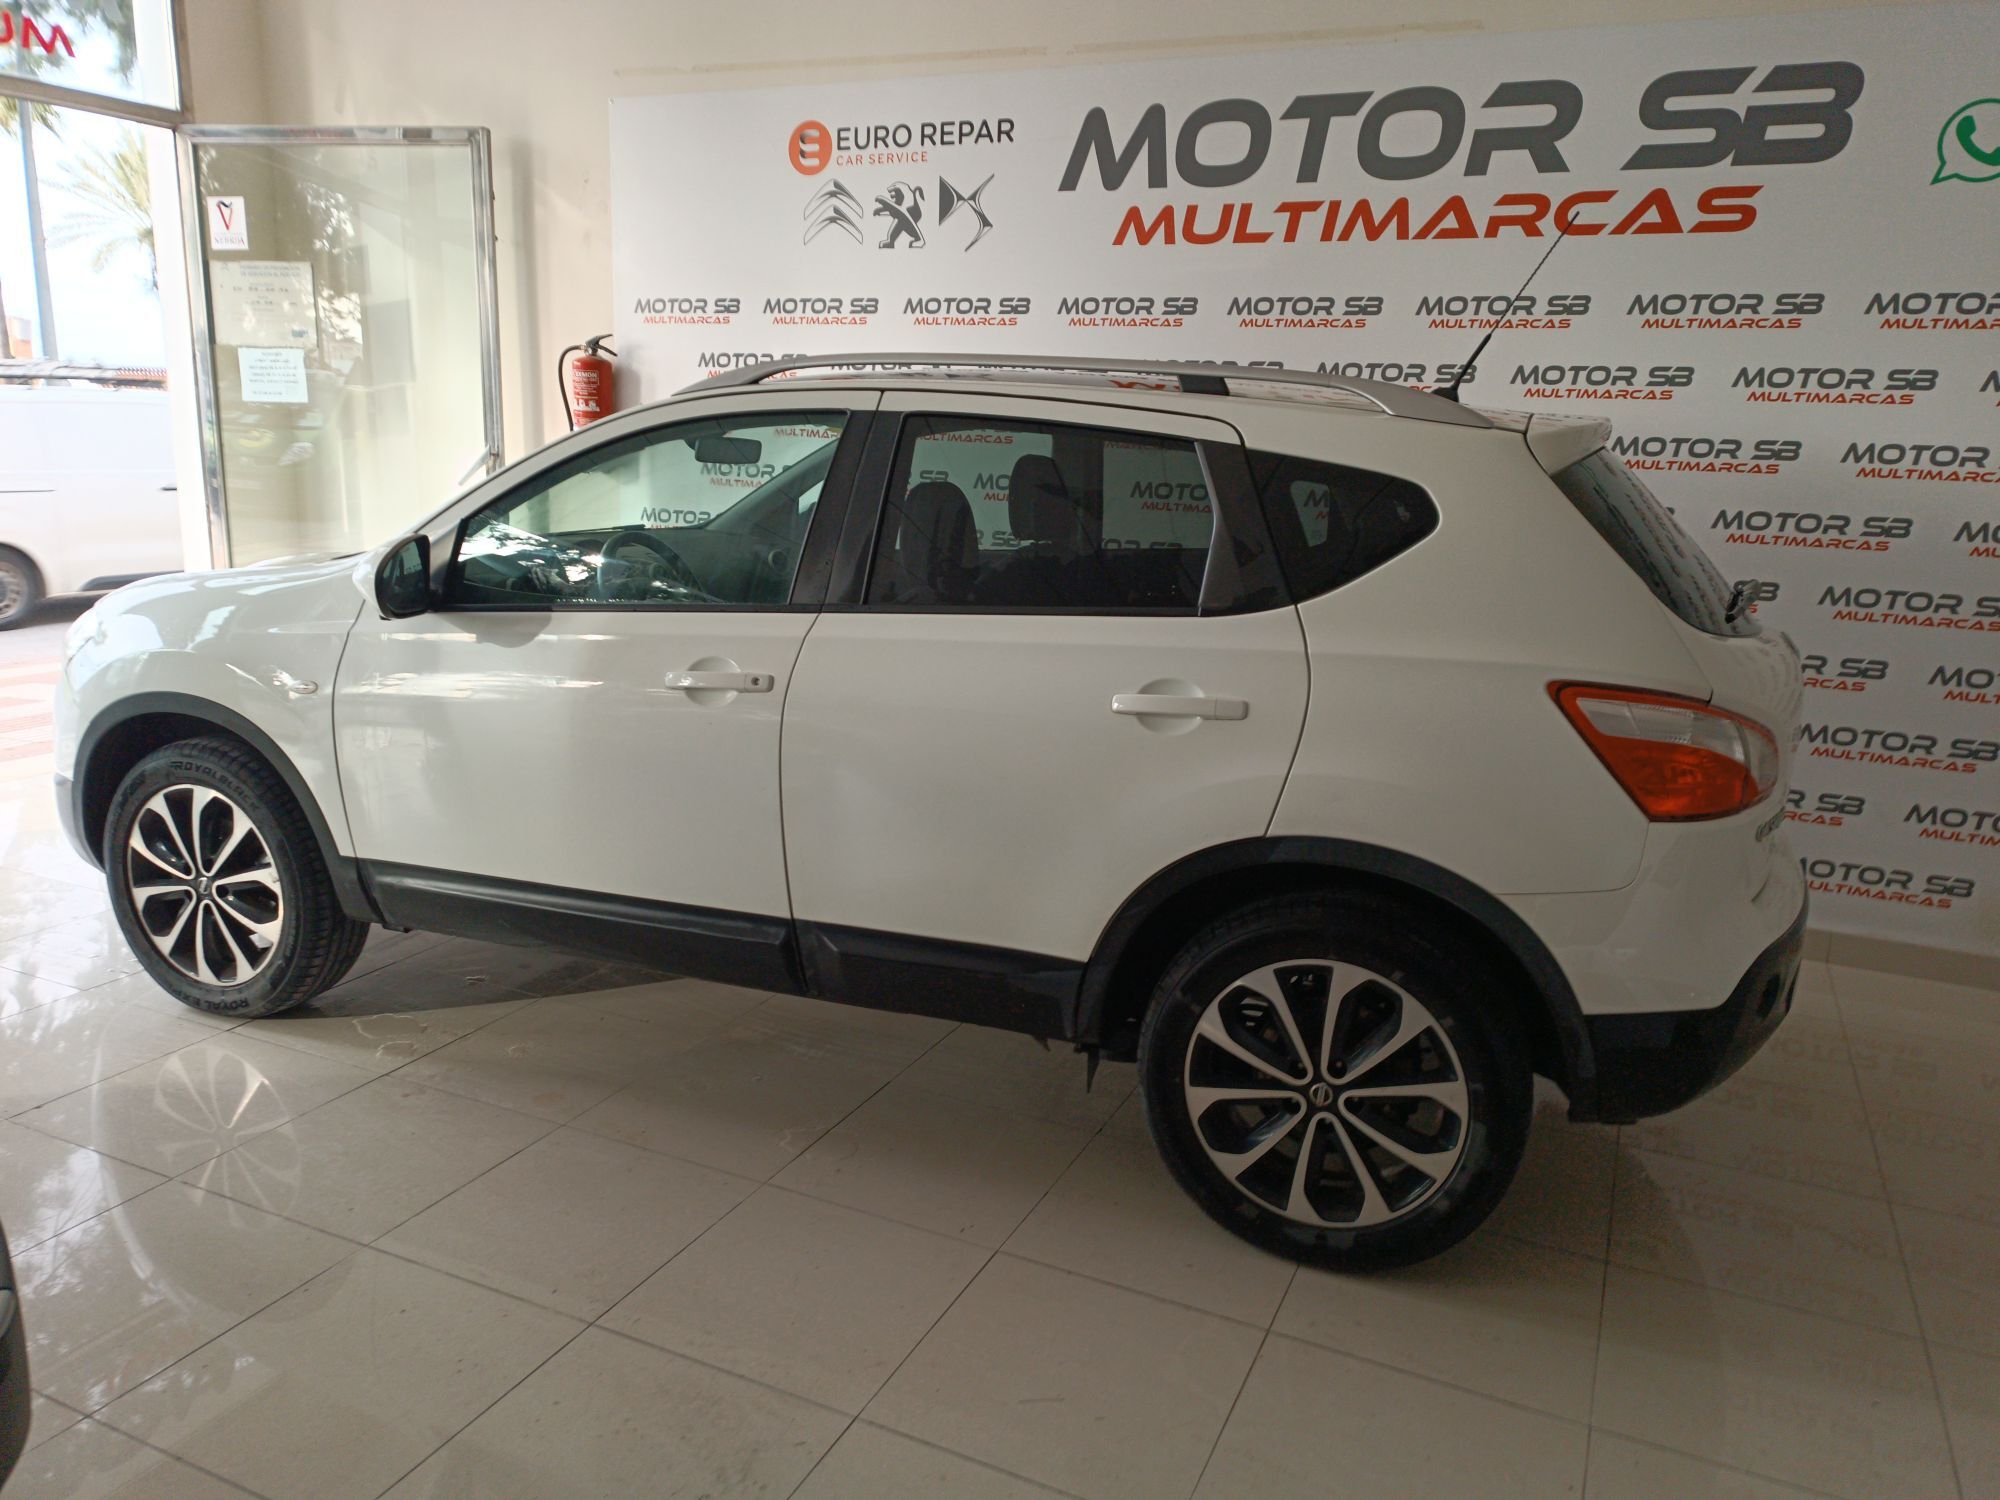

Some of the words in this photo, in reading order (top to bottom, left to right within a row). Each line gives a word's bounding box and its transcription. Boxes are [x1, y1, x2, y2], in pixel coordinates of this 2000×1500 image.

[837, 124, 912, 150] EURO
[921, 119, 1014, 146] REPAR
[1057, 80, 1584, 192] MOTOR
[1620, 61, 1864, 170] SB
[836, 154, 863, 166] CAR
[870, 152, 928, 163] SERVICE
[1112, 186, 1762, 245] MULTIMARCAS
[635, 298, 707, 313] MOTOR
[714, 298, 740, 313] SB
[763, 298, 842, 314] MOTOR
[850, 298, 878, 314] SB
[904, 298, 991, 314] MOTOR
[998, 298, 1030, 314] SB
[1058, 297, 1154, 315] MOTOR
[1162, 297, 1198, 315] SB
[1227, 297, 1335, 315] MOTOR
[1343, 297, 1383, 315] SB
[1416, 295, 1538, 316] MOTOR
[1545, 295, 1591, 315] SB
[1627, 294, 1763, 315] MOTOR
[1772, 293, 1825, 314] SB
[642, 315, 731, 324] MULTIMARCAS
[772, 316, 867, 326] MULTIMARCAS
[915, 317, 1017, 326] MULTIMARCAS
[1069, 317, 1182, 327] MULTIMARCAS
[1240, 318, 1365, 328] MULTIMARCAS
[1429, 319, 1569, 329] MULTIMARCAS
[1642, 318, 1800, 328] MULTIMARCAS
[1317, 361, 1425, 382] MOTOR
[1433, 364, 1477, 383] SB
[1510, 365, 1637, 386] MOTOR
[1645, 367, 1694, 386] SB
[1732, 367, 1874, 389] MOTOR
[1884, 369, 1938, 390] SB
[1524, 388, 1672, 400] MULTIMARCAS
[1747, 392, 1913, 405] MULTIMARCAS
[1612, 437, 1742, 459] MOTOR
[1751, 440, 1802, 461] SB
[1840, 443, 1990, 468] MOTOR
[1624, 460, 1778, 474] MULTIMARCAS
[1711, 510, 1850, 535] MOTOR
[1859, 517, 1913, 538] SB
[1726, 534, 1888, 551] MULTIMARCAS
[1818, 586, 1963, 614] MOTOR
[1833, 611, 2000, 632] MULTIMARCAS
[1837, 658, 1888, 679] SB
[1800, 724, 1937, 755] MOTOR
[1948, 739, 2000, 761] SB
[1810, 747, 1976, 774] MULTIMARCAS
[1816, 794, 1865, 815] SB
[1809, 860, 1913, 889] OTOR
[1923, 875, 1974, 897] SB
[1808, 881, 1952, 909] ULTIMARCAS
